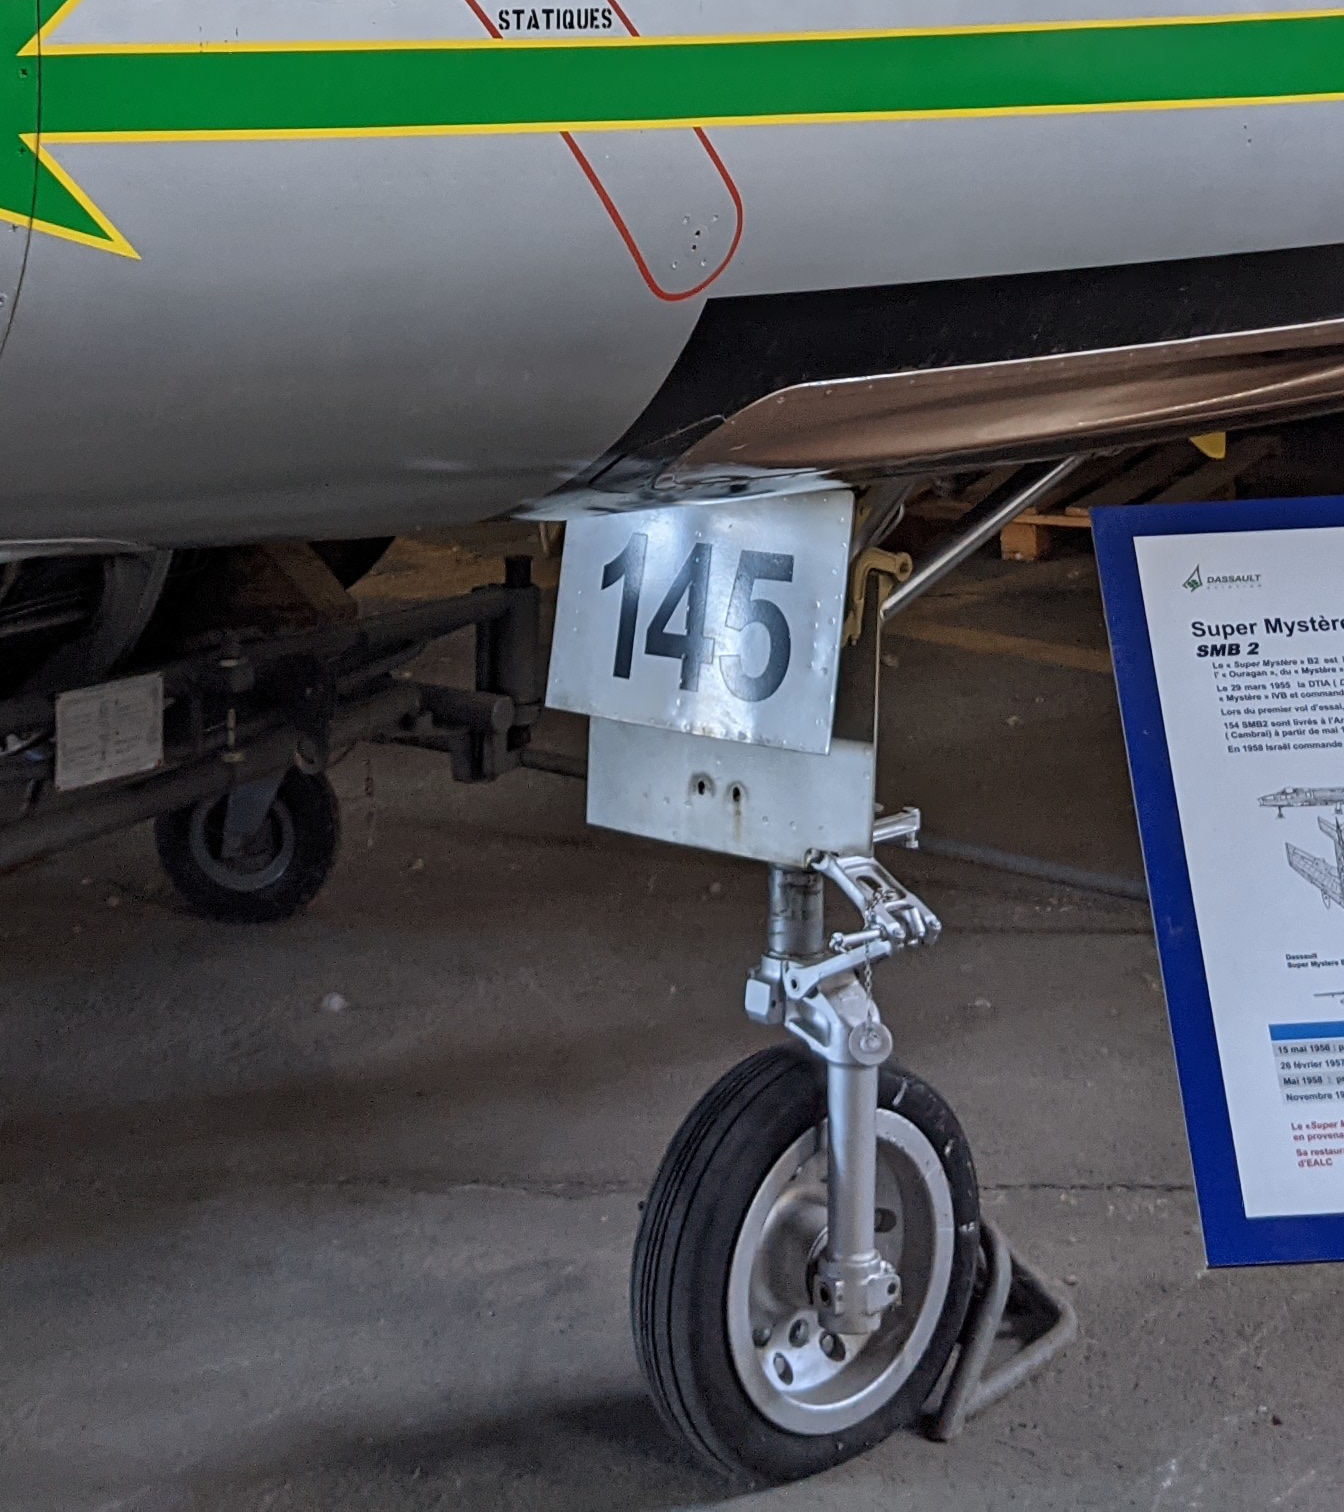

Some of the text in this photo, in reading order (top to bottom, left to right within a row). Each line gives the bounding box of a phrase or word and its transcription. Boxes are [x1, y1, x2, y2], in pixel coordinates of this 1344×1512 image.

[497, 7, 614, 32] STATIQUES
[1206, 573, 1261, 584] DASSAULT
[600, 532, 795, 703] 145
[1190, 620, 1257, 640] Super
[1195, 641, 1260, 658] SMB 2
[1233, 660, 1261, 669] Super
[1228, 669, 1268, 678] Ouragan
[1256, 705, 1292, 716] premier
[1230, 727, 1306, 739] Cambrai) partir
[1292, 739, 1343, 750] commande
[1292, 1060, 1322, 1069] février
[1285, 1091, 1333, 1102] Novembre
